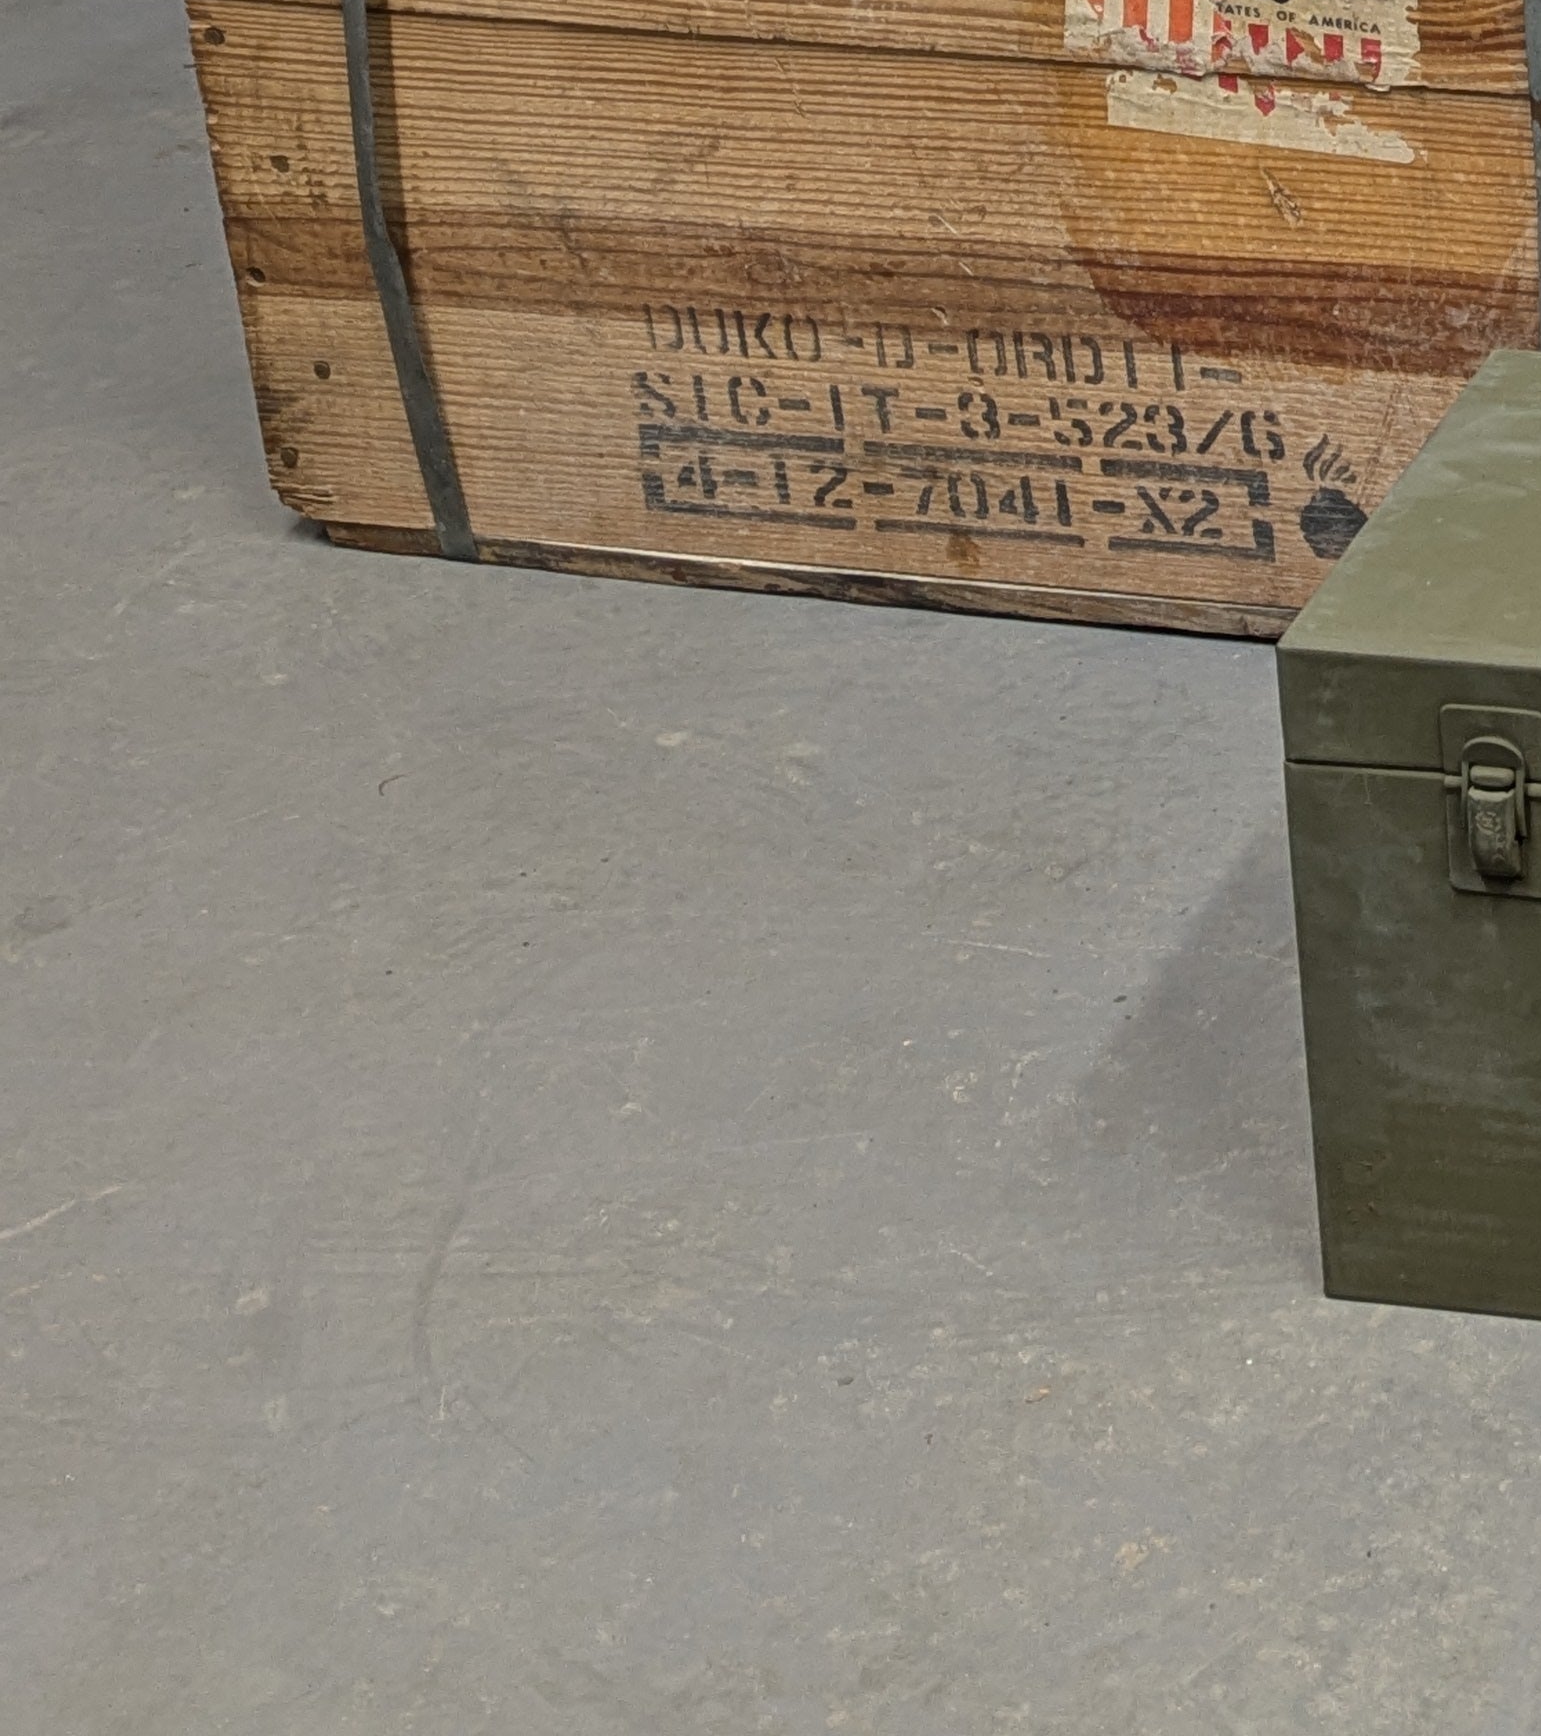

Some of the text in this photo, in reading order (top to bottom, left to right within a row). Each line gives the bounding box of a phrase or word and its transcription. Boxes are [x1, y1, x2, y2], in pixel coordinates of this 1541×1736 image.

[1213, 1, 1382, 35] TATES OF AMERICA
